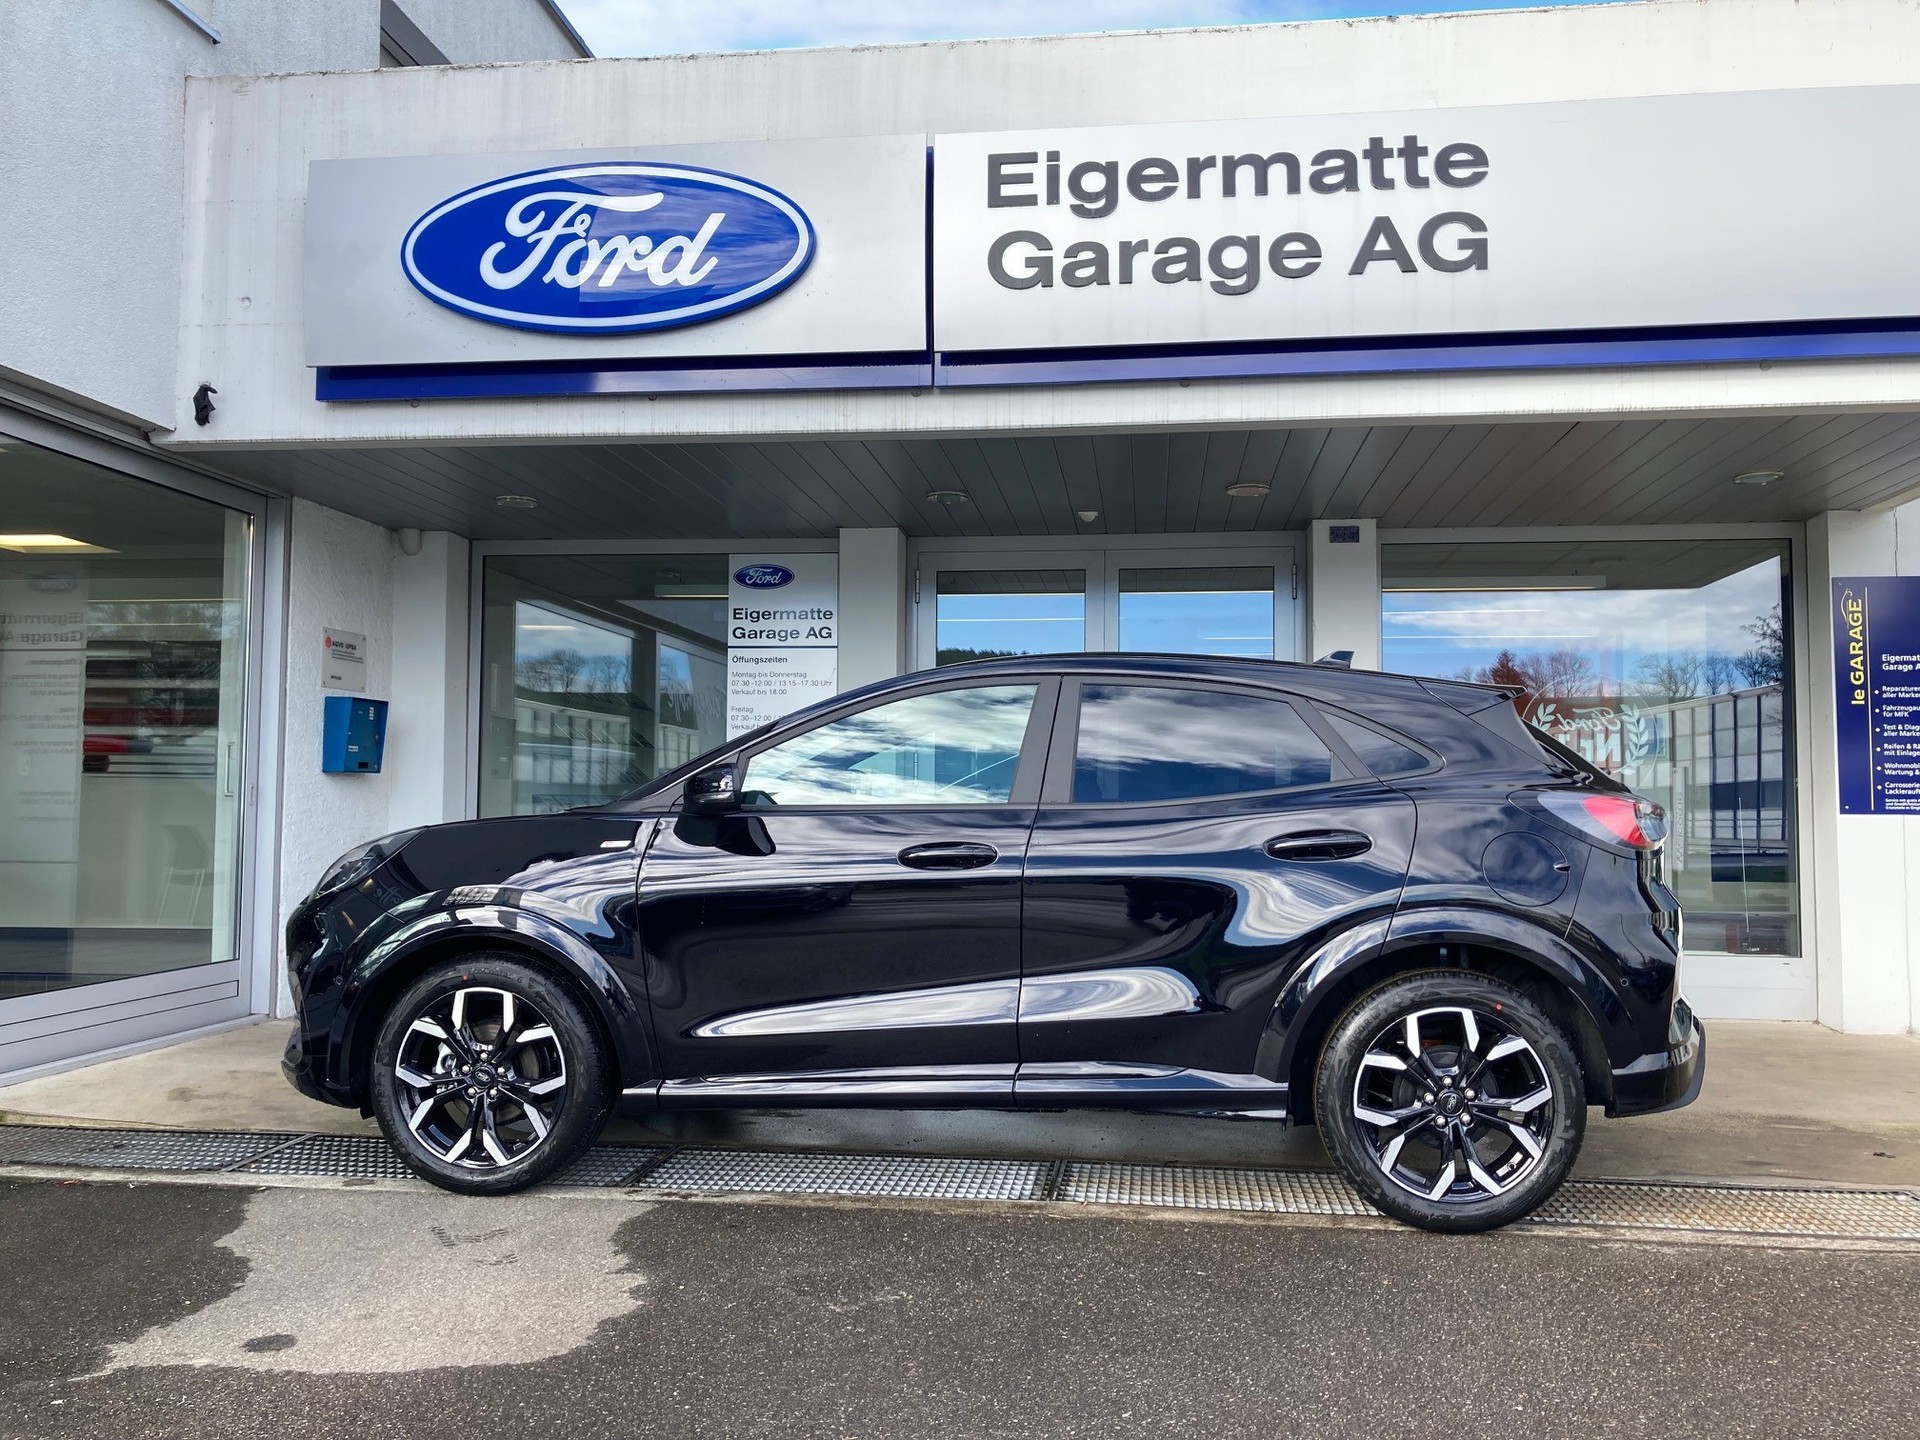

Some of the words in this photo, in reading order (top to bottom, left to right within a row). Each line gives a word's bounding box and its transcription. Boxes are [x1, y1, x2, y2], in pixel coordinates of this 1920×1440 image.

[988, 135, 1489, 219] Eigermatte
[480, 191, 726, 290] Ford
[987, 230, 1323, 296] Garage
[1348, 211, 1489, 276] AG
[745, 567, 783, 585] Ford
[732, 607, 834, 623] Eigermatte
[732, 626, 800, 642] Garage
[805, 626, 833, 639] AG
[1848, 598, 1865, 686] GARAGE
[731, 671, 757, 679] Montag
[769, 671, 807, 679] Donnerstag
[1882, 663, 1914, 672] Garage
[1851, 689, 1865, 705] le
[731, 706, 754, 714] Freitag
[1884, 769, 1914, 777] Wartung
